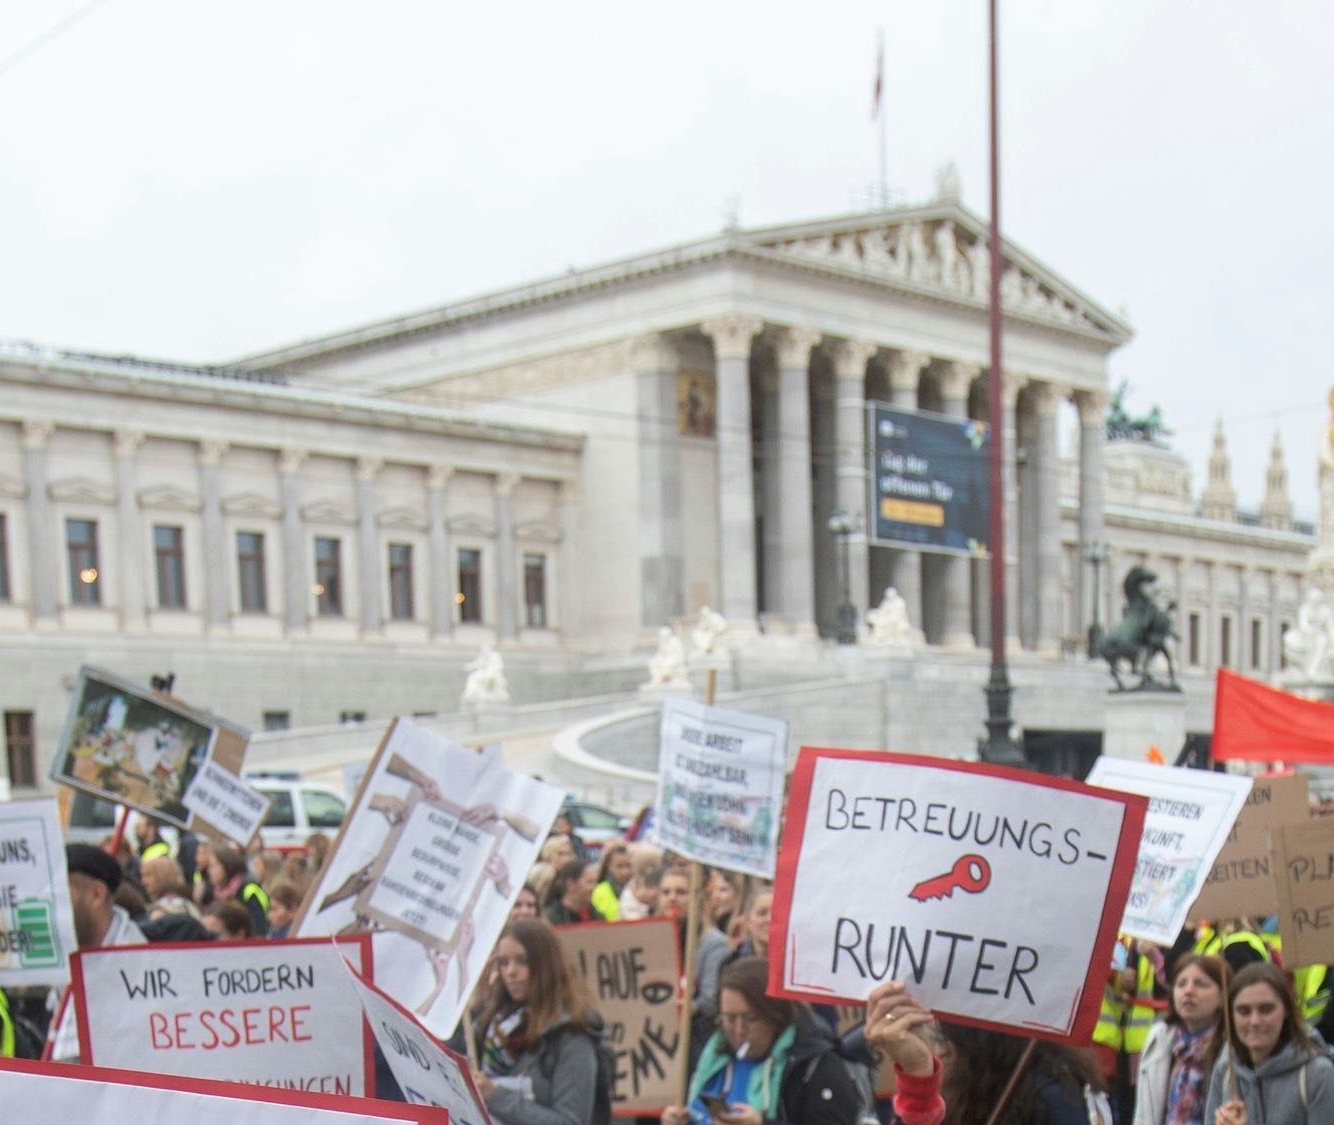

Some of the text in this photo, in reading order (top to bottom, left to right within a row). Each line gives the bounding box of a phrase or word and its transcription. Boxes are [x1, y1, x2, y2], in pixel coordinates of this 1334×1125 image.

[825, 788, 1107, 865] BETREUUNGS-
[1149, 798, 1205, 822] ESTIEREN
[120, 964, 315, 999] WIR FORDERN
[831, 917, 1037, 1005] RUNTER
[149, 1005, 312, 1050] BESSERE
